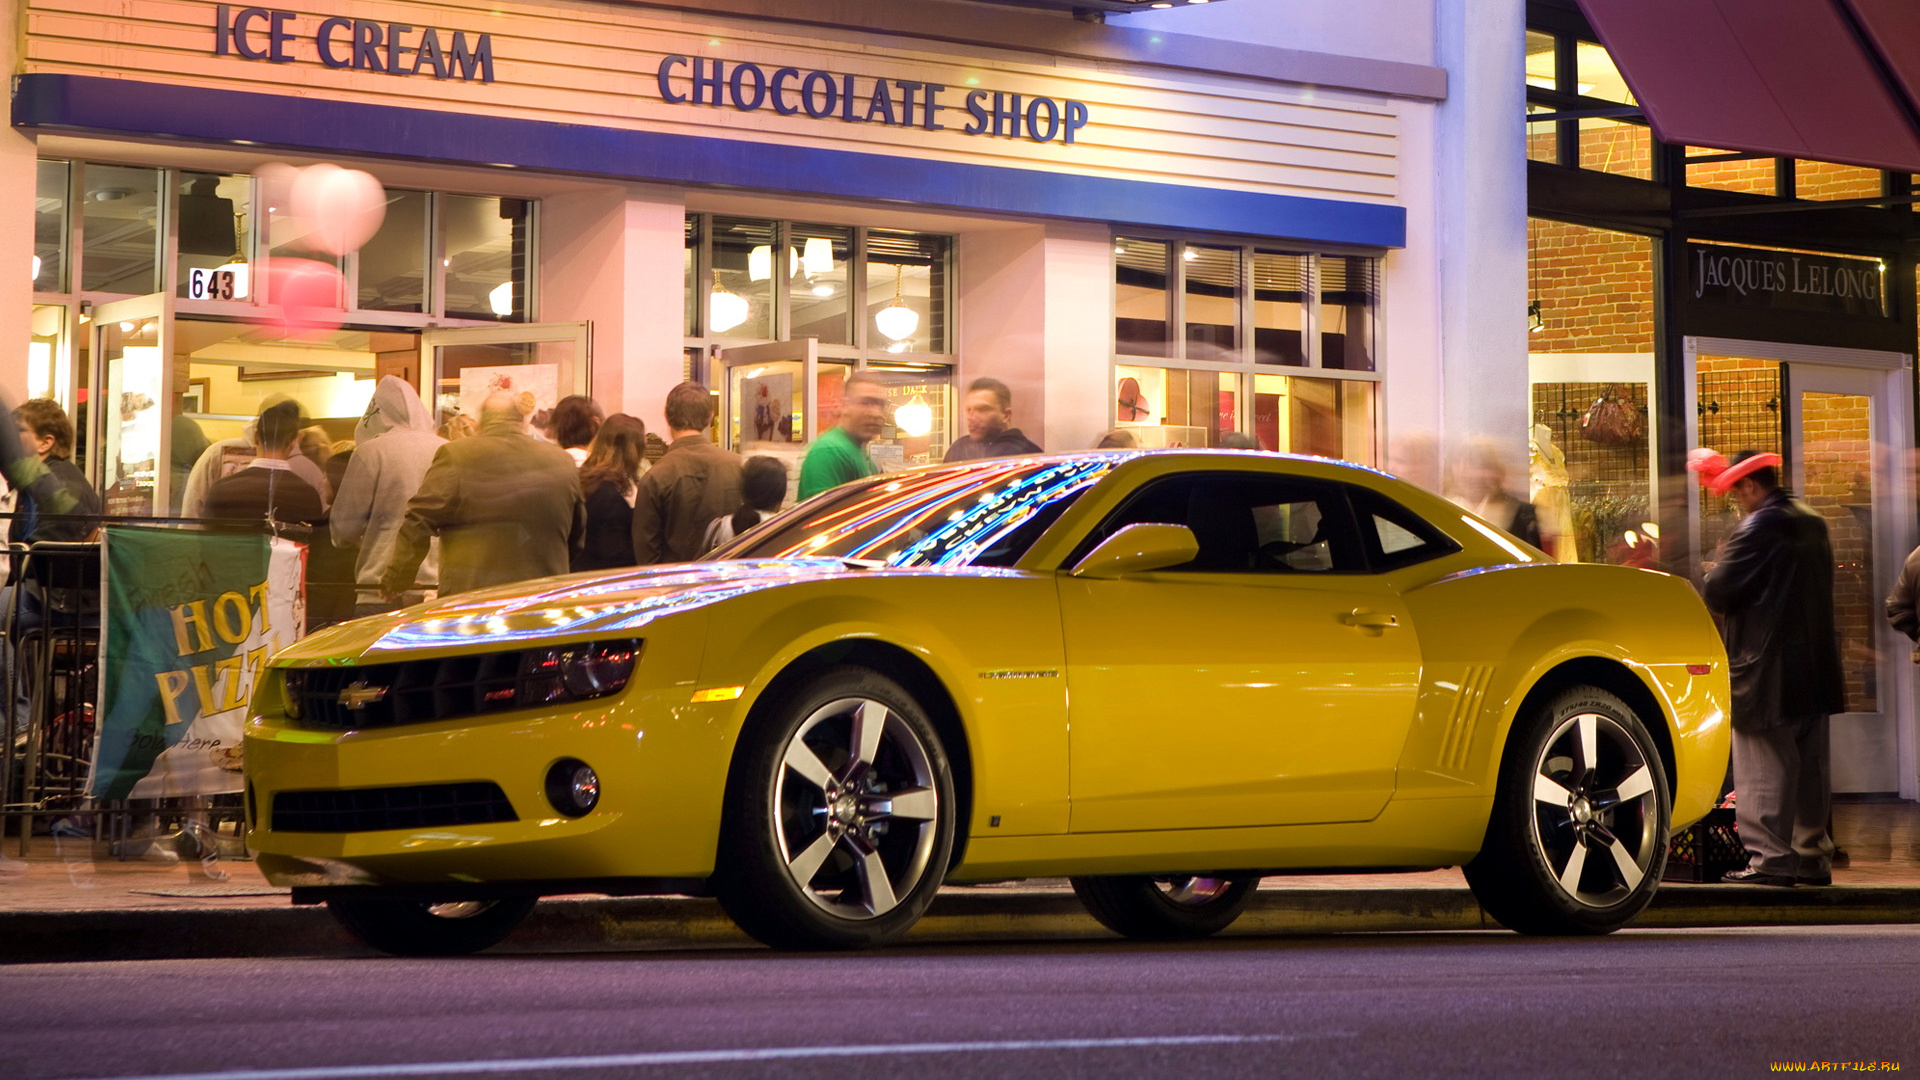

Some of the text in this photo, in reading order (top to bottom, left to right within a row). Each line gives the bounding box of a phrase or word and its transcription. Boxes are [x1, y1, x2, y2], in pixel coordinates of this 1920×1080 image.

[216, 4, 495, 83] ICE CREAM
[657, 54, 1089, 145] CHOCOLATE SHOP
[192, 269, 234, 301] 643
[169, 579, 272, 657] HOT
[154, 634, 278, 726] PIZZ
